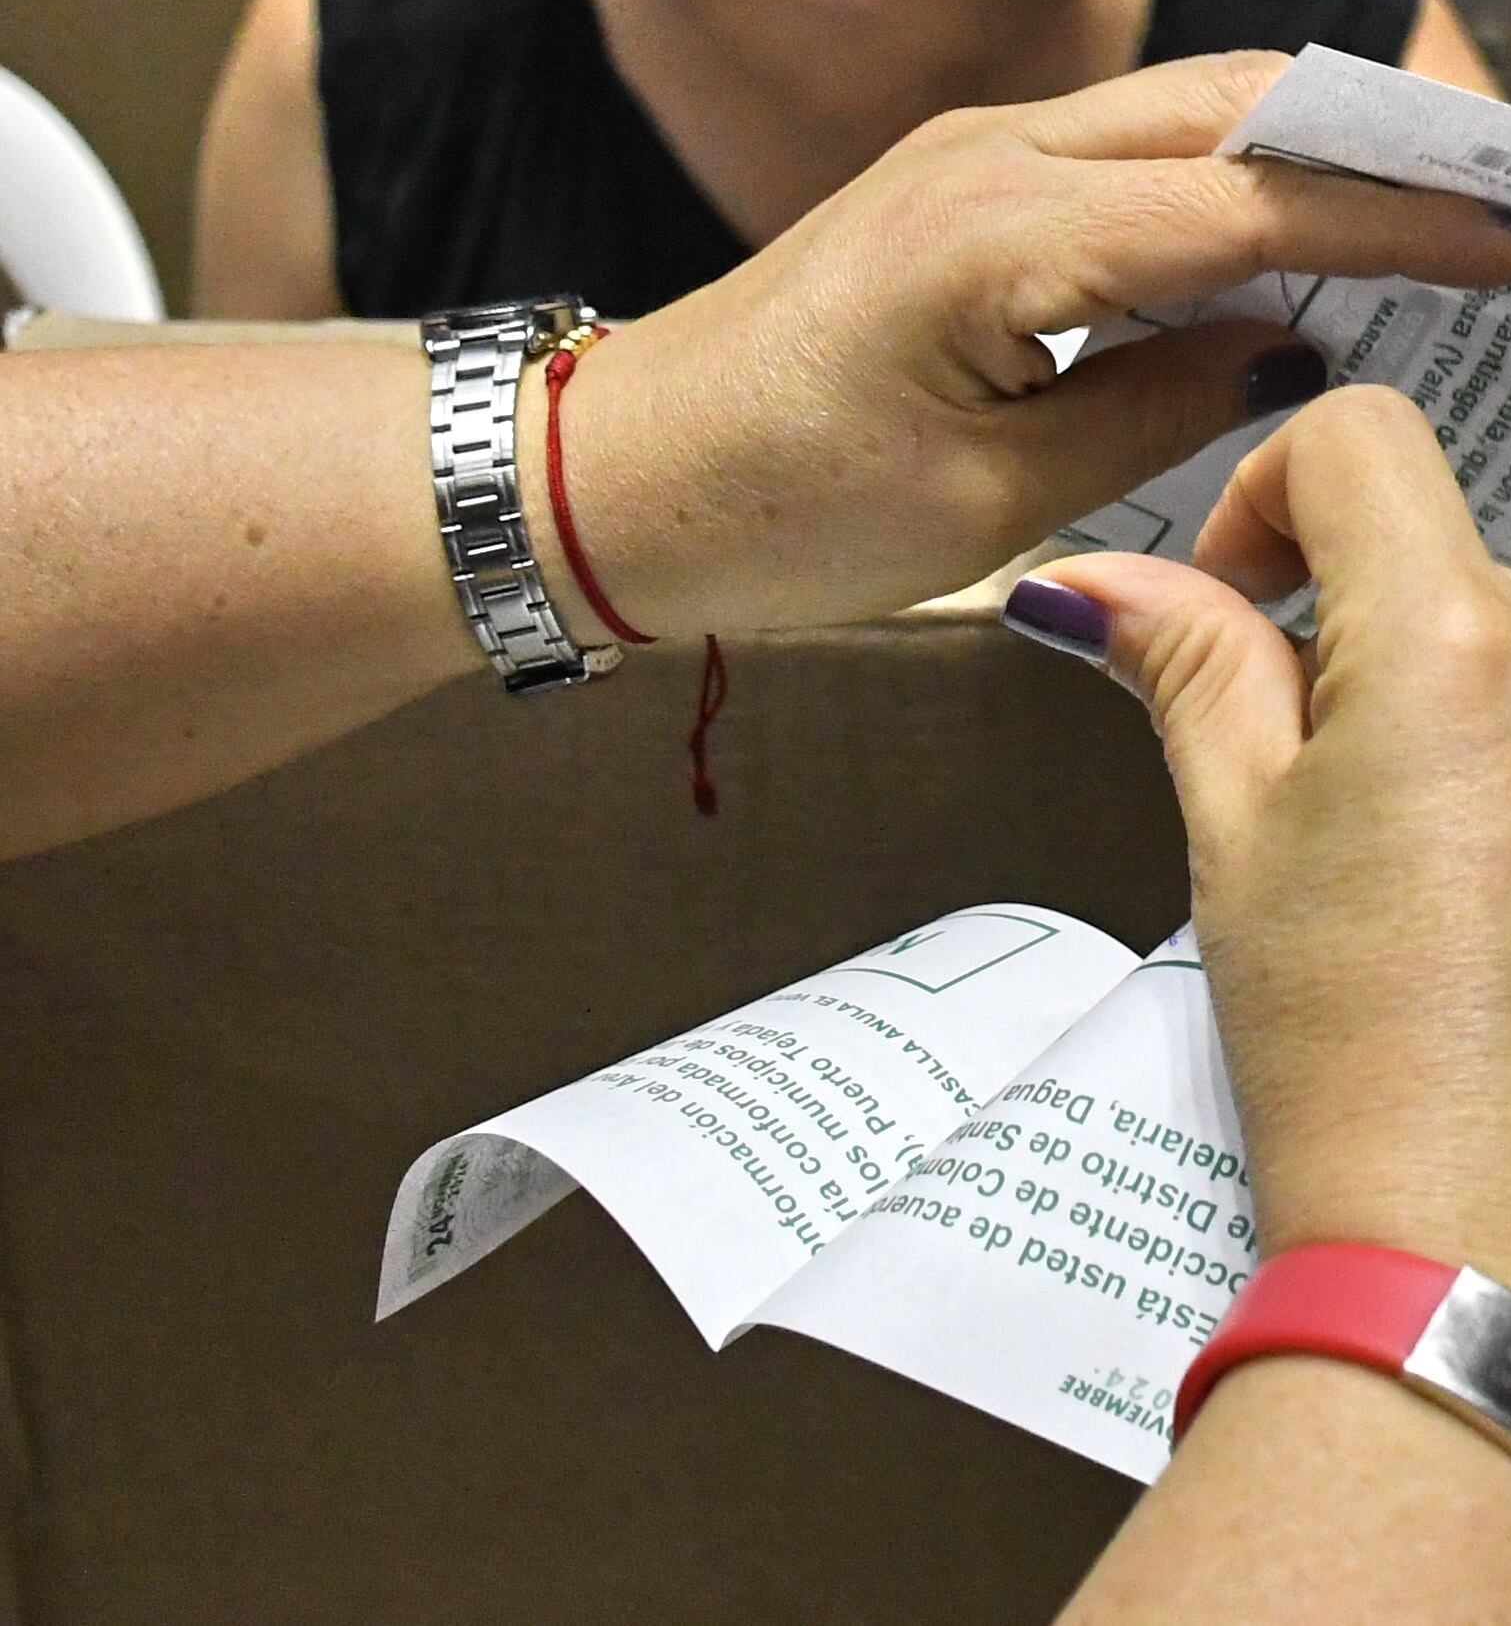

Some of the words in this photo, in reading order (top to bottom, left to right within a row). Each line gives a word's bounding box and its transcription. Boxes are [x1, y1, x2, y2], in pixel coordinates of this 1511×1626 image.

[737, 1021, 809, 1061] Tejada
[837, 1002, 904, 1040] ANULA
[632, 1078, 684, 1105] del
[677, 1064, 822, 1174] conformada
[714, 1041, 849, 1142] municipios
[810, 1057, 896, 1135] Puerto
[846, 1144, 890, 1194] los
[1029, 1132, 1072, 1165] de
[1109, 1099, 1249, 1187] delaria,
[680, 1099, 827, 1253] nformación
[1015, 1180, 1060, 1215] de
[1081, 1151, 1218, 1234] Distrito
[968, 1215, 1013, 1252] de
[1069, 1201, 1250, 1294] occidente
[1017, 1237, 1126, 1300] usted
[1136, 1286, 1219, 1346] Está
[1059, 1374, 1173, 1440] VIEMBRE
